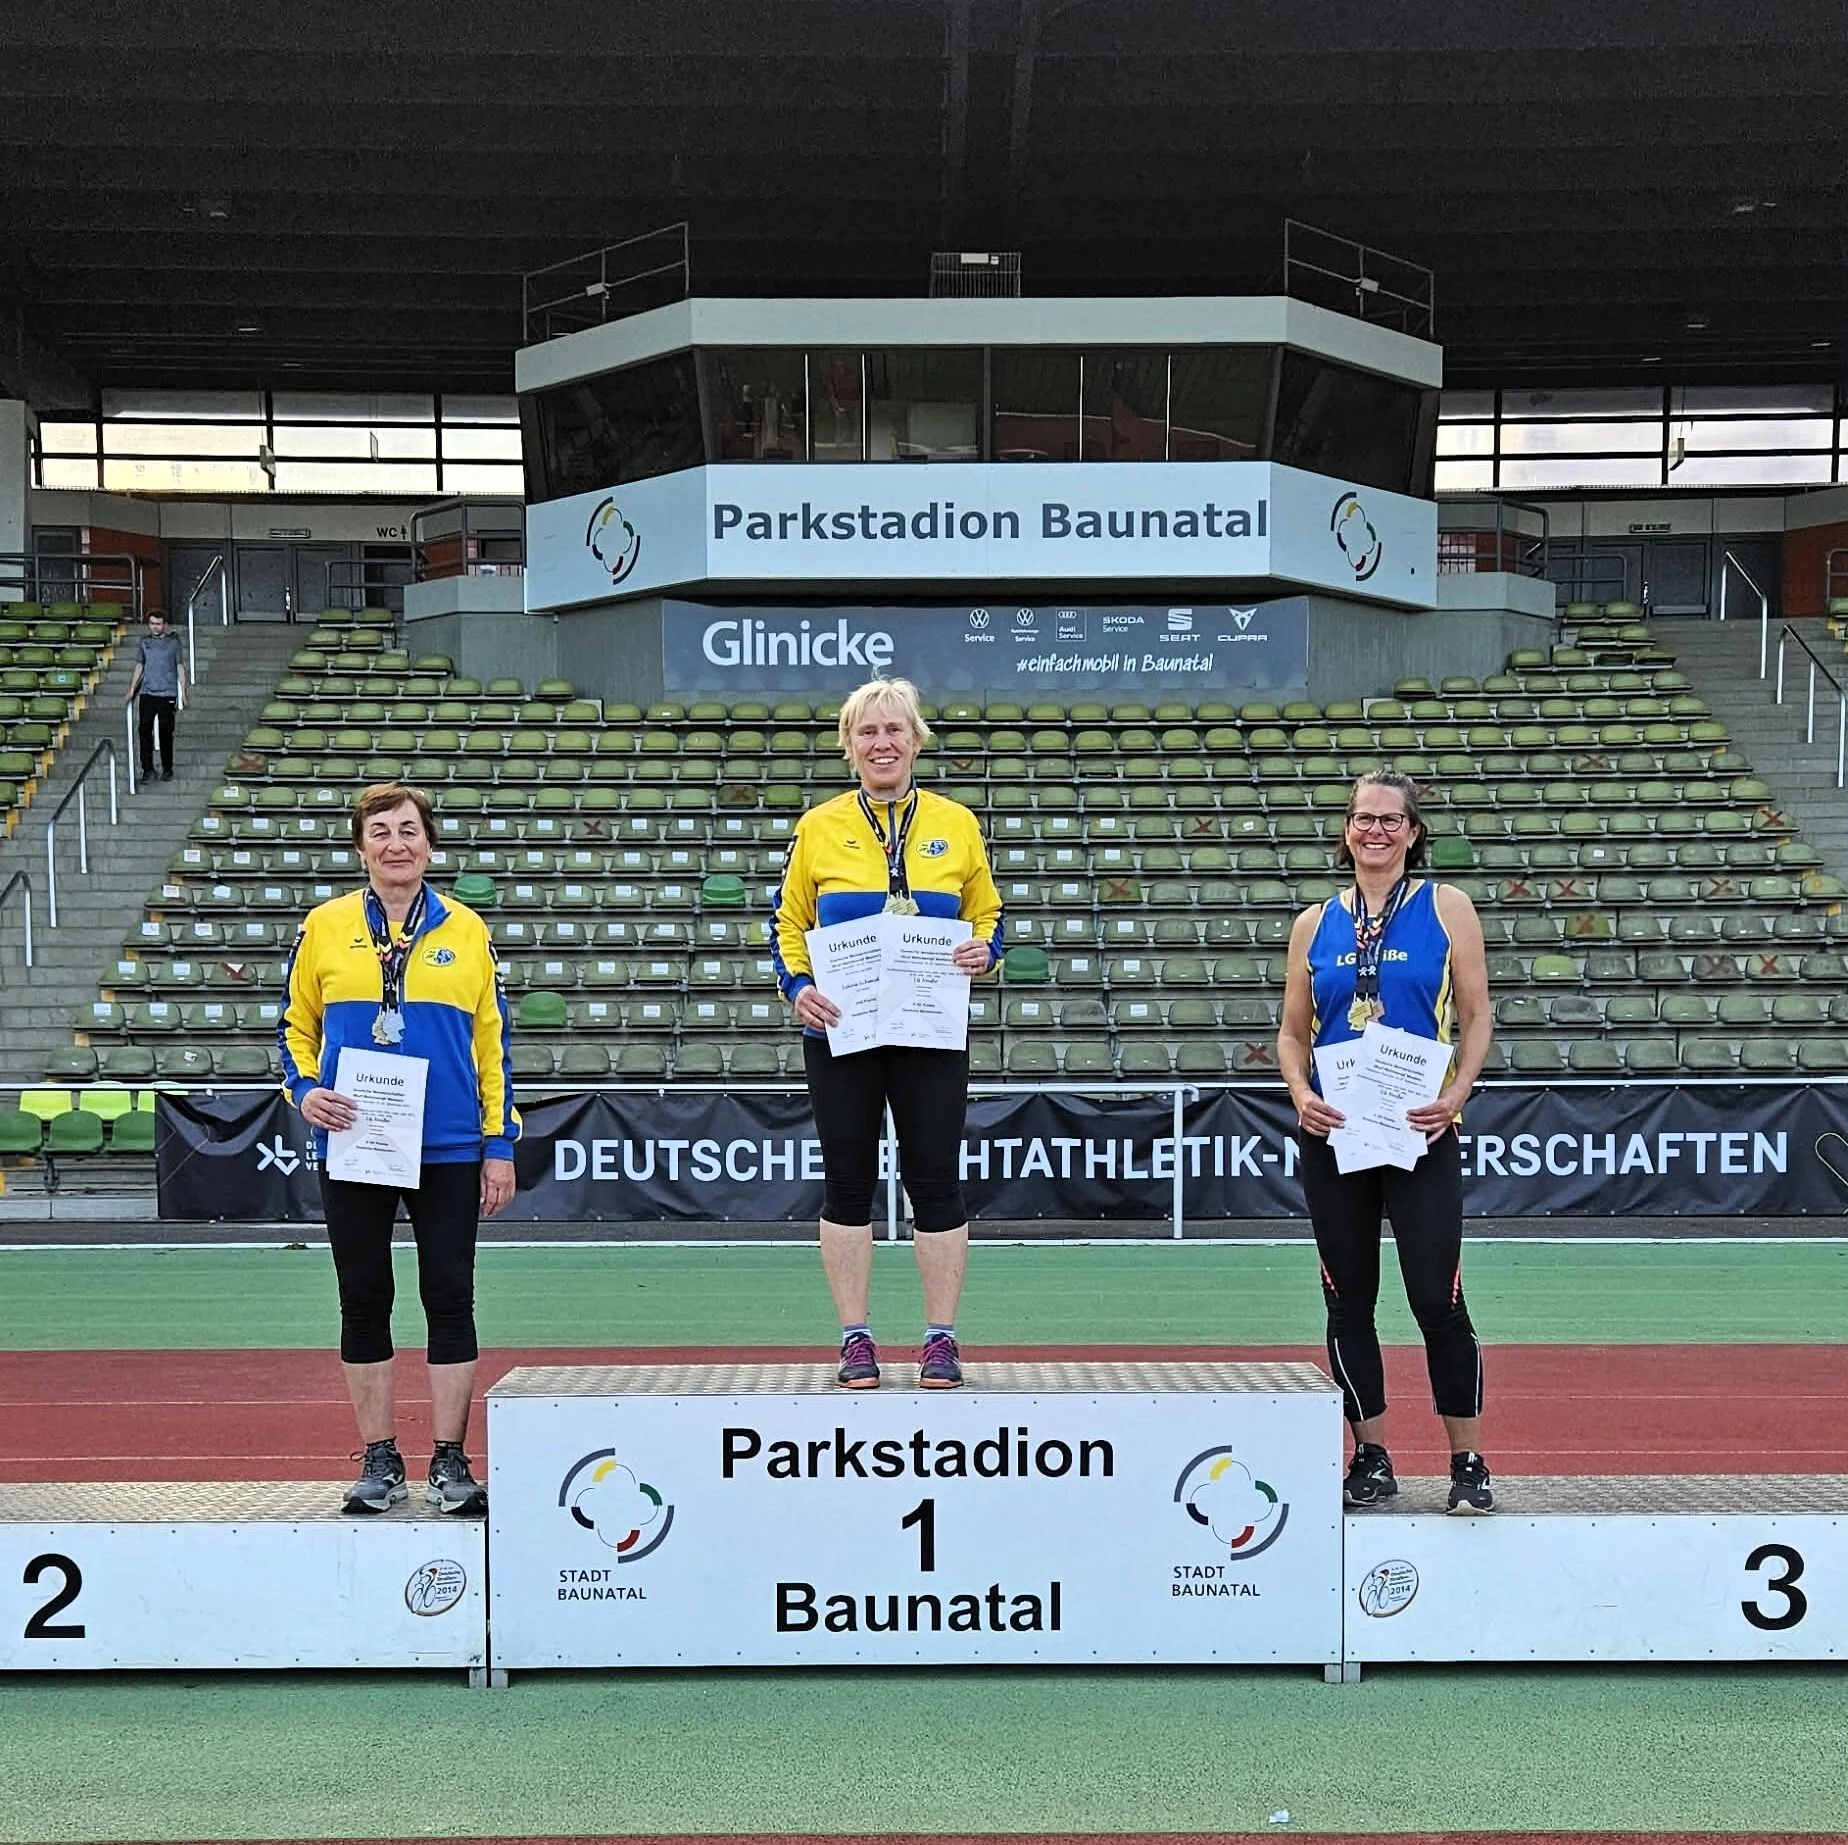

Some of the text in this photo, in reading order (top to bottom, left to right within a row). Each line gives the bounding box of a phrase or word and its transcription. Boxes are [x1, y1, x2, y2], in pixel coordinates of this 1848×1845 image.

[714, 499, 1267, 540] Parkstadion Baunatal
[376, 527, 397, 538] WC
[1102, 624, 1129, 633] Service
[702, 618, 895, 667] Glinicke
[964, 633, 995, 643] Service
[1159, 634, 1201, 642] SEAT
[1217, 634, 1268, 642] CUPRA
[1016, 653, 1214, 673] #einfachmobil in Baunatal
[828, 933, 877, 953] Urkunde
[902, 933, 952, 947] Urkunde
[1336, 952, 1357, 967] LG
[1379, 1043, 1427, 1067] Urkunde
[356, 1072, 405, 1087] Urkunde
[554, 1138, 826, 1182] DEUTSCHE
[722, 1426, 1114, 1479] Parkstadion
[901, 1498, 935, 1572] 1
[559, 1569, 613, 1583] STADT
[1173, 1565, 1226, 1579] STADT
[436, 1585, 457, 1595] 2014
[557, 1586, 648, 1601] BAUNATAL
[1172, 1583, 1261, 1597] BAUNATAL
[1390, 1584, 1411, 1595] 2014
[1740, 1543, 1808, 1631] 3
[22, 1552, 86, 1639] 2
[776, 1581, 1061, 1633] Baunatal
